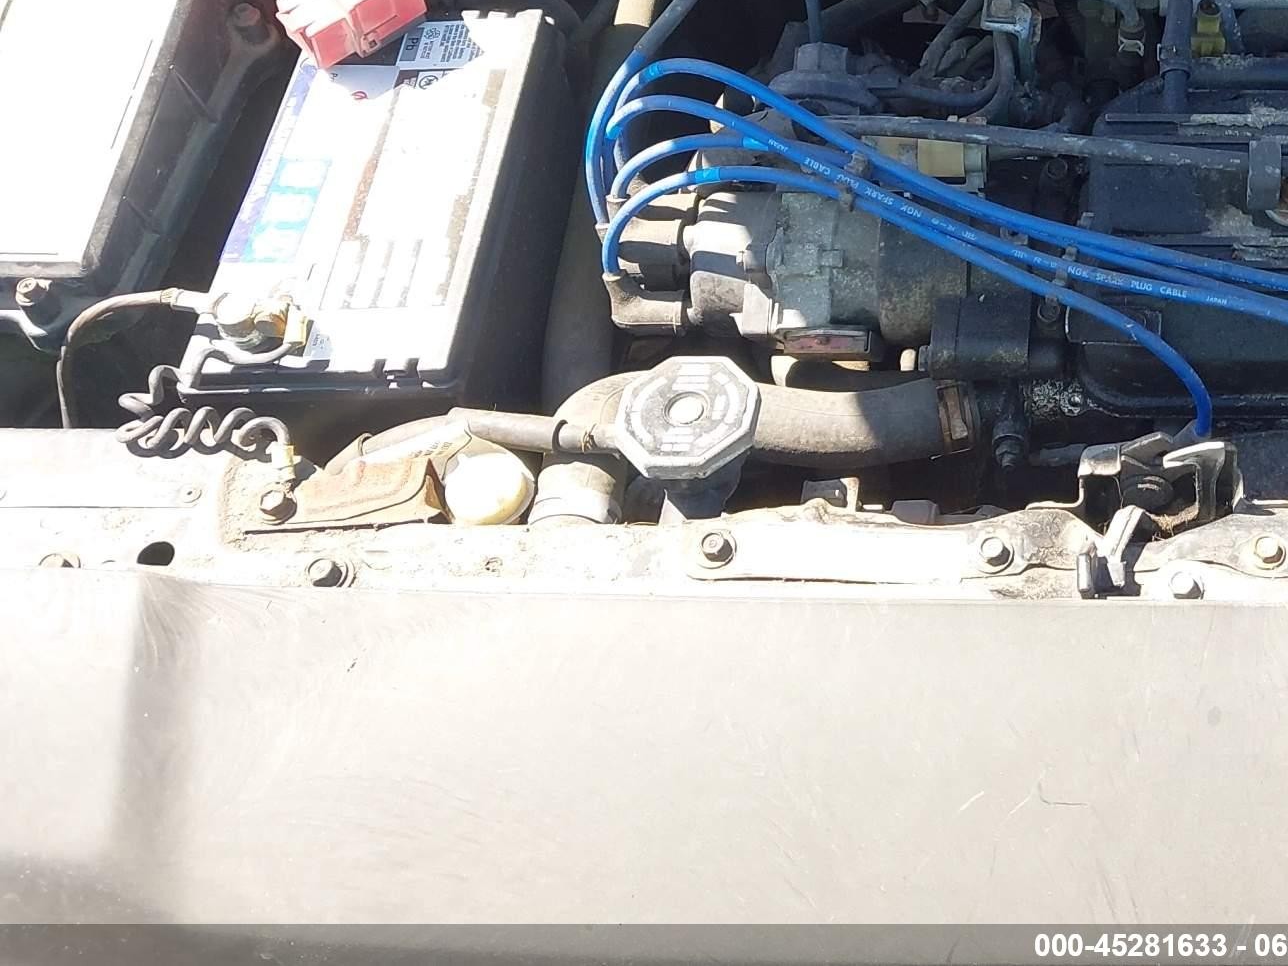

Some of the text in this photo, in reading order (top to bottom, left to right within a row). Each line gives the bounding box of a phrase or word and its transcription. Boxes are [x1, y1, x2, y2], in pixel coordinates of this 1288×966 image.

[405, 37, 420, 51] Pb
[803, 156, 831, 176] CABLE
[863, 186, 896, 207] SPARK
[1130, 279, 1153, 292] PLUG
[1159, 285, 1189, 299] CABLE
[1205, 295, 1229, 306] JAPAN
